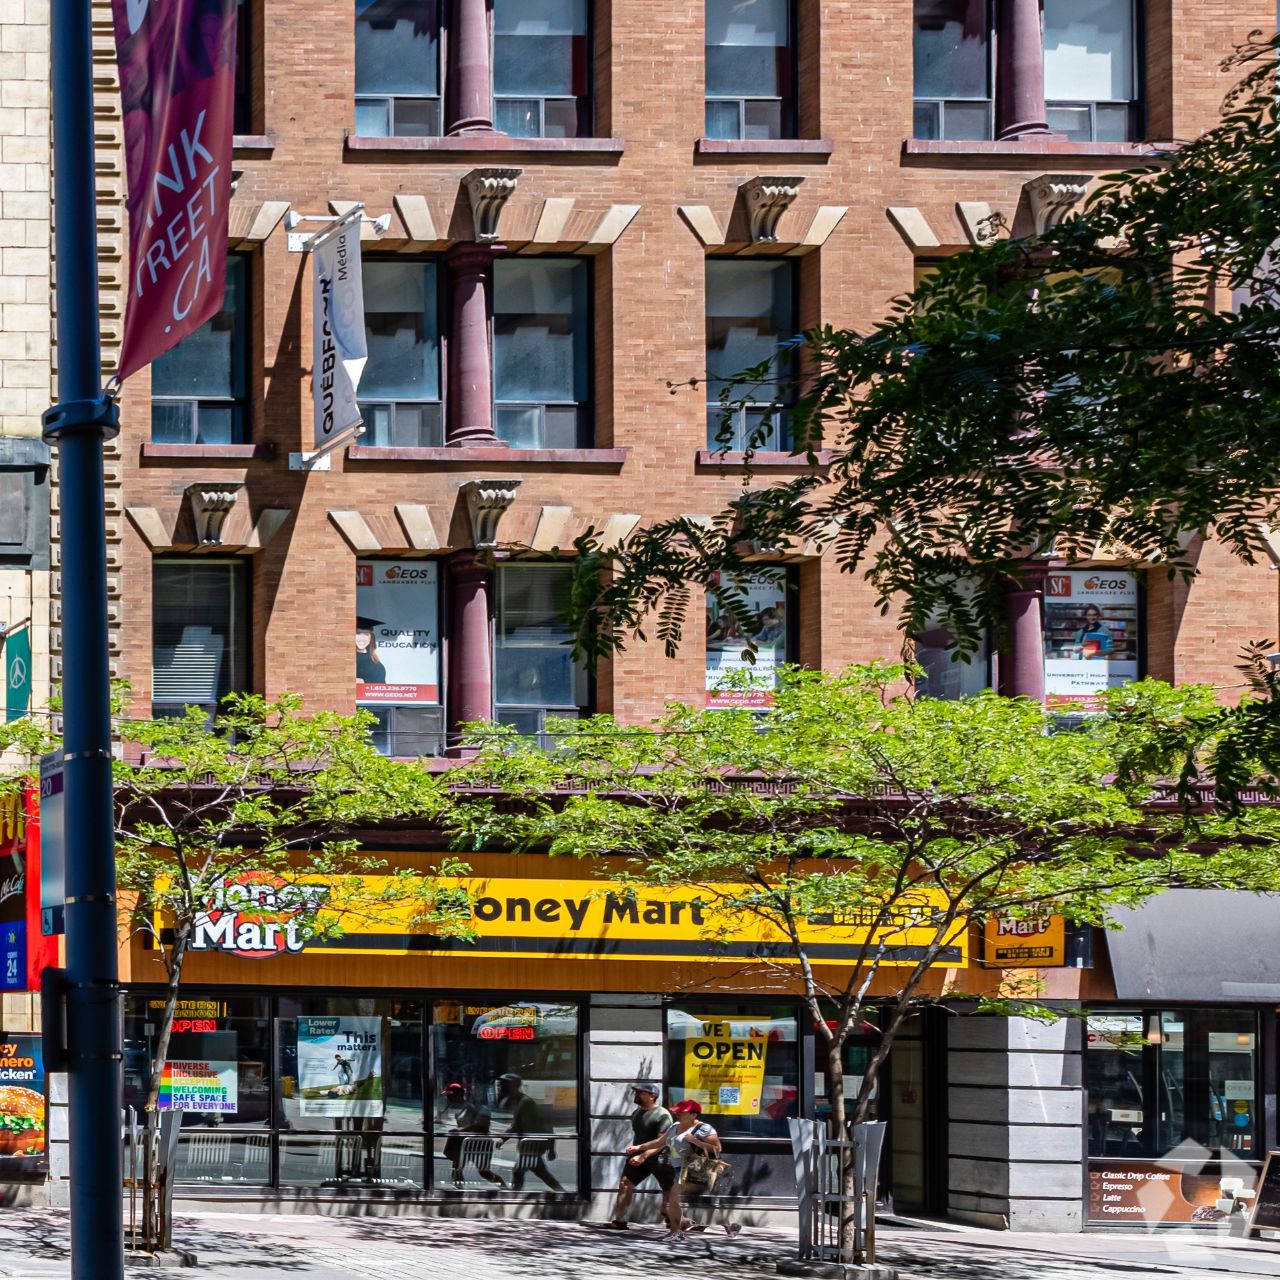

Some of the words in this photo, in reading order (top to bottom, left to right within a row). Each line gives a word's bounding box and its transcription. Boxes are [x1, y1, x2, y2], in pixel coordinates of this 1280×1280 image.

[136, 165, 220, 298] TREET
[337, 234, 348, 281] Média
[385, 565, 429, 579] GEOS
[1083, 576, 1127, 590] GEOS
[380, 628, 431, 637] QUALITY
[377, 640, 437, 649] EDUCATION
[41, 777, 52, 799] 20
[0, 872, 25, 903] McCafé
[473, 896, 591, 931] oney
[602, 894, 705, 926] Mart
[192, 911, 305, 952] Mart
[998, 918, 1046, 935] Mart
[6, 959, 18, 978] 24
[309, 1027, 336, 1035] Rates
[342, 1030, 377, 1044] This
[480, 1026, 534, 1040] OPEN
[336, 1043, 377, 1051] matters
[693, 1041, 764, 1060] OPEN
[172, 1062, 210, 1070] DIVERSE
[172, 1070, 218, 1078] INCLUSIVE
[172, 1086, 228, 1095] WELCOMING
[172, 1094, 196, 1102] SAFE
[198, 1095, 228, 1103] SPACE
[172, 1102, 191, 1110] FOR
[192, 1102, 237, 1110] EVERYONE
[1101, 1171, 1126, 1180] Classic
[1127, 1172, 1145, 1181] Drip
[1145, 1172, 1171, 1182] Coffee
[1102, 1182, 1134, 1191] Espresso
[1102, 1193, 1123, 1202] Latte
[1102, 1204, 1147, 1214] Cappuccino
